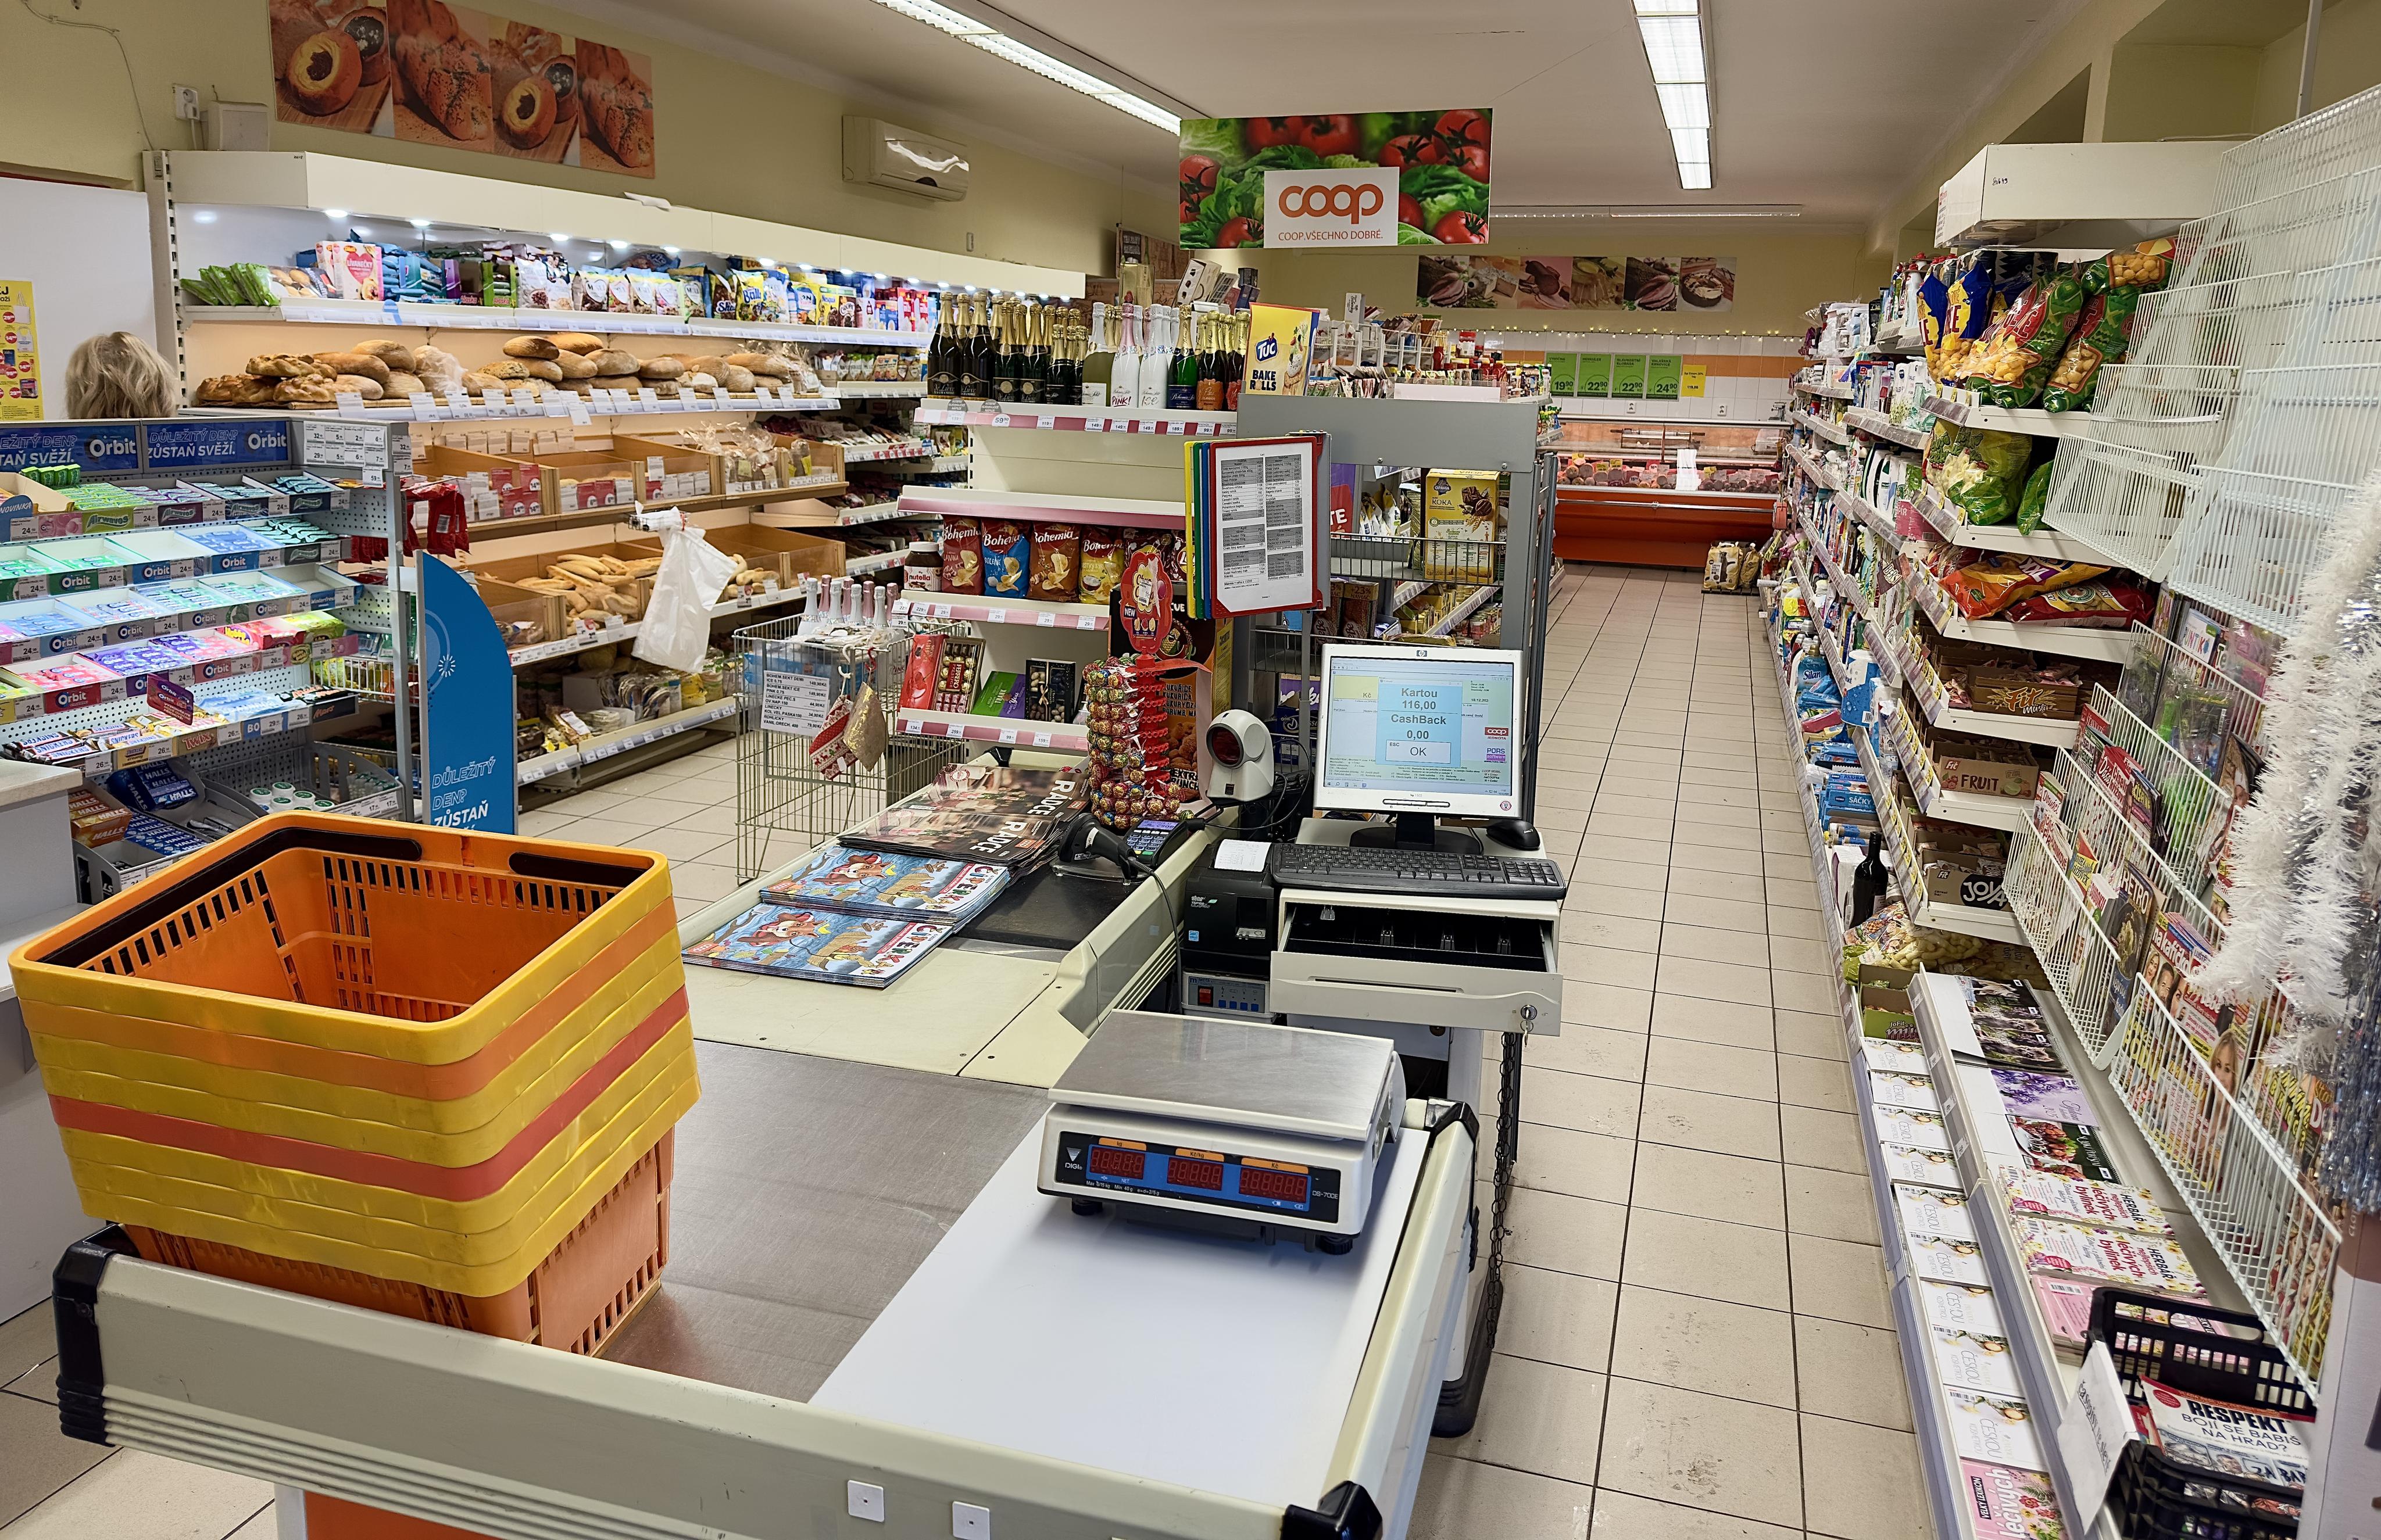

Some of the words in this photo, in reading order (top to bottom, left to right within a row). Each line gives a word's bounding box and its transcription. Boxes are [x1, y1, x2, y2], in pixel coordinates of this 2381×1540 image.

[1279, 184, 1384, 224] coop
[1257, 342, 1276, 359] TUC
[1252, 370, 1276, 381] BAKE
[1249, 379, 1277, 393] ROLLS
[1111, 396, 1132, 407] PINK!
[42, 435, 77, 448] DEN?
[150, 425, 208, 443] DŮLEŽITÝ
[208, 429, 238, 442] DEN?
[248, 432, 287, 450] Orbit
[90, 437, 137, 457] Orbit
[198, 440, 236, 456] SVĚŽÍ.
[29, 449, 75, 464] SVĚŽÍ.
[144, 564, 170, 579] Orbit
[222, 556, 246, 570] Orbit
[2018, 556, 2051, 583] XXL
[62, 574, 91, 589] Orbit
[257, 603, 277, 615] Orbit
[1124, 607, 1136, 617] NEW
[194, 613, 216, 625] Orbit
[120, 625, 142, 639] Orbit
[205, 664, 230, 677] Orbit
[953, 664, 961, 690] FERRERO
[1803, 669, 1821, 681] Silan
[58, 690, 87, 708] Orbit
[1401, 687, 1438, 698] Kartou
[2004, 687, 2039, 714] Fit
[1402, 700, 1436, 710] 116,00
[1390, 714, 1447, 725] CashBack
[1406, 730, 1429, 740] 0,00
[1410, 747, 1427, 757] OK
[145, 767, 171, 779] HALLS
[432, 756, 496, 789] DŮLEŽITÝ
[1946, 760, 1959, 771] Fit
[152, 776, 176, 788] HALLS
[1961, 774, 2000, 792] FRUIT
[127, 782, 148, 811] HALLS
[169, 788, 197, 801] HALLS
[432, 788, 467, 811] DEN?
[1027, 779, 1076, 816] RÁDCE
[1849, 795, 1872, 805] SÁČKY
[78, 804, 106, 815] HALLS
[98, 808, 127, 820] HALLS
[434, 800, 489, 827] ZŮSTAŇ
[92, 826, 126, 840] HALLS
[969, 821, 1027, 854] RÁDCE
[1937, 870, 1950, 880] Fit
[1962, 882, 2008, 907] JOYA
[2122, 871, 2149, 912] RETRO
[2074, 1185, 2099, 1215] bylinek
[2091, 1186, 2118, 1222] léčivých
[2110, 1192, 2130, 1219] nejlepších
[2119, 1193, 2147, 1223] HERBÁŘ
[2098, 1239, 2123, 1272] bylinek
[2116, 1240, 2146, 1278] léčivých
[2136, 1247, 2158, 1276] nejlepších
[2147, 1247, 2178, 1280] HERBÁŘ
[1946, 1291, 1966, 1324] ČESKOU
[1961, 1350, 1979, 1385] ČESKOU
[2186, 1399, 2289, 1434] RESPEKT
[1979, 1418, 2003, 1459] ČESKOU
[2182, 1413, 2218, 1430] BOJÍ
[2223, 1424, 2247, 1435] SE
[2249, 1429, 2301, 1446] BABIŠ
[2202, 1427, 2226, 1440] NA
[2230, 1434, 2288, 1452] HRAD?
[1972, 1477, 1986, 1502] LEXIKON
[1976, 1501, 1990, 1518] VELKÝ
[1985, 1468, 2026, 1539] léčivých
